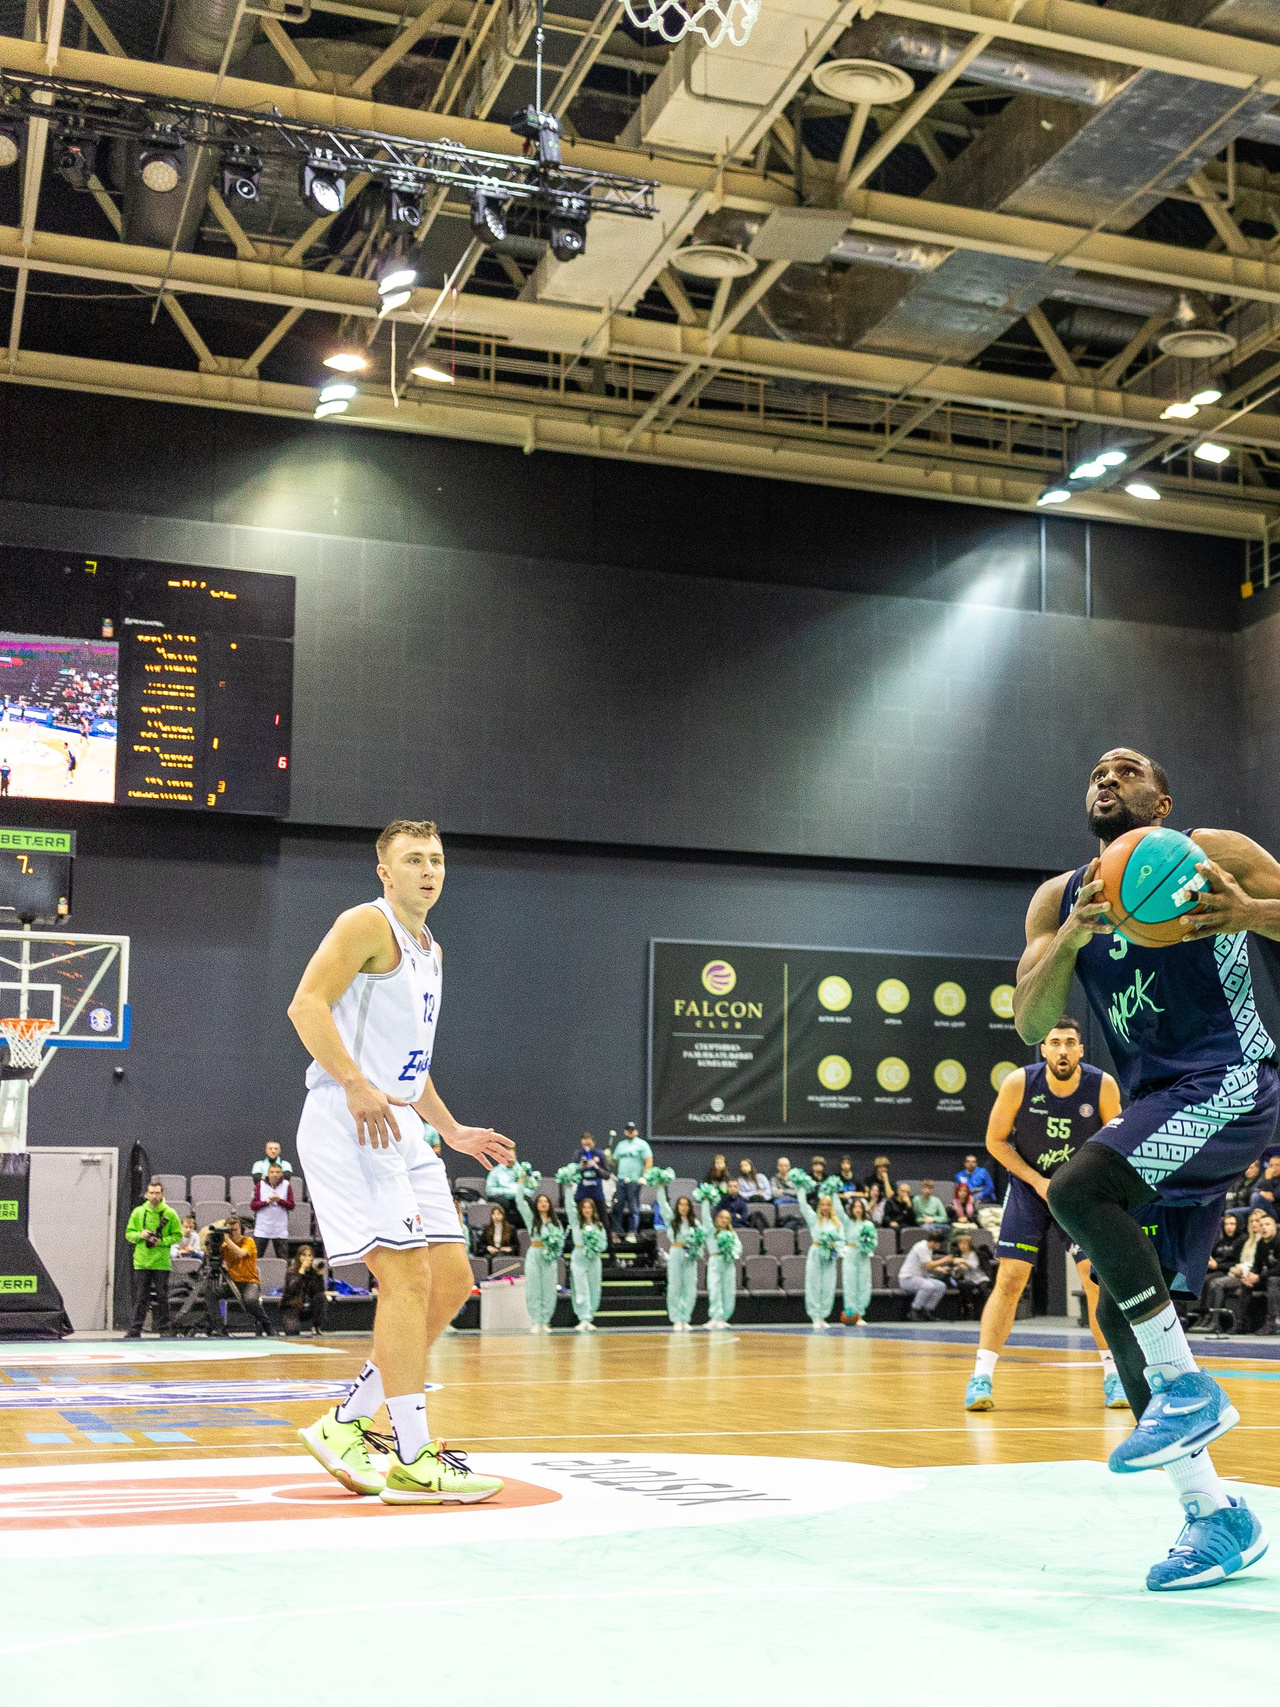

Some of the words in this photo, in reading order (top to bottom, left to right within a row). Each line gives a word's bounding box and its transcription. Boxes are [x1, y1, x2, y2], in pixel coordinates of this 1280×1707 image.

[277, 756, 288, 769] 6
[207, 793, 216, 806] 3
[0, 834, 66, 848] BETERA
[423, 992, 435, 1024] 12
[674, 999, 764, 1019] FALCON
[1046, 1116, 1071, 1139] 55
